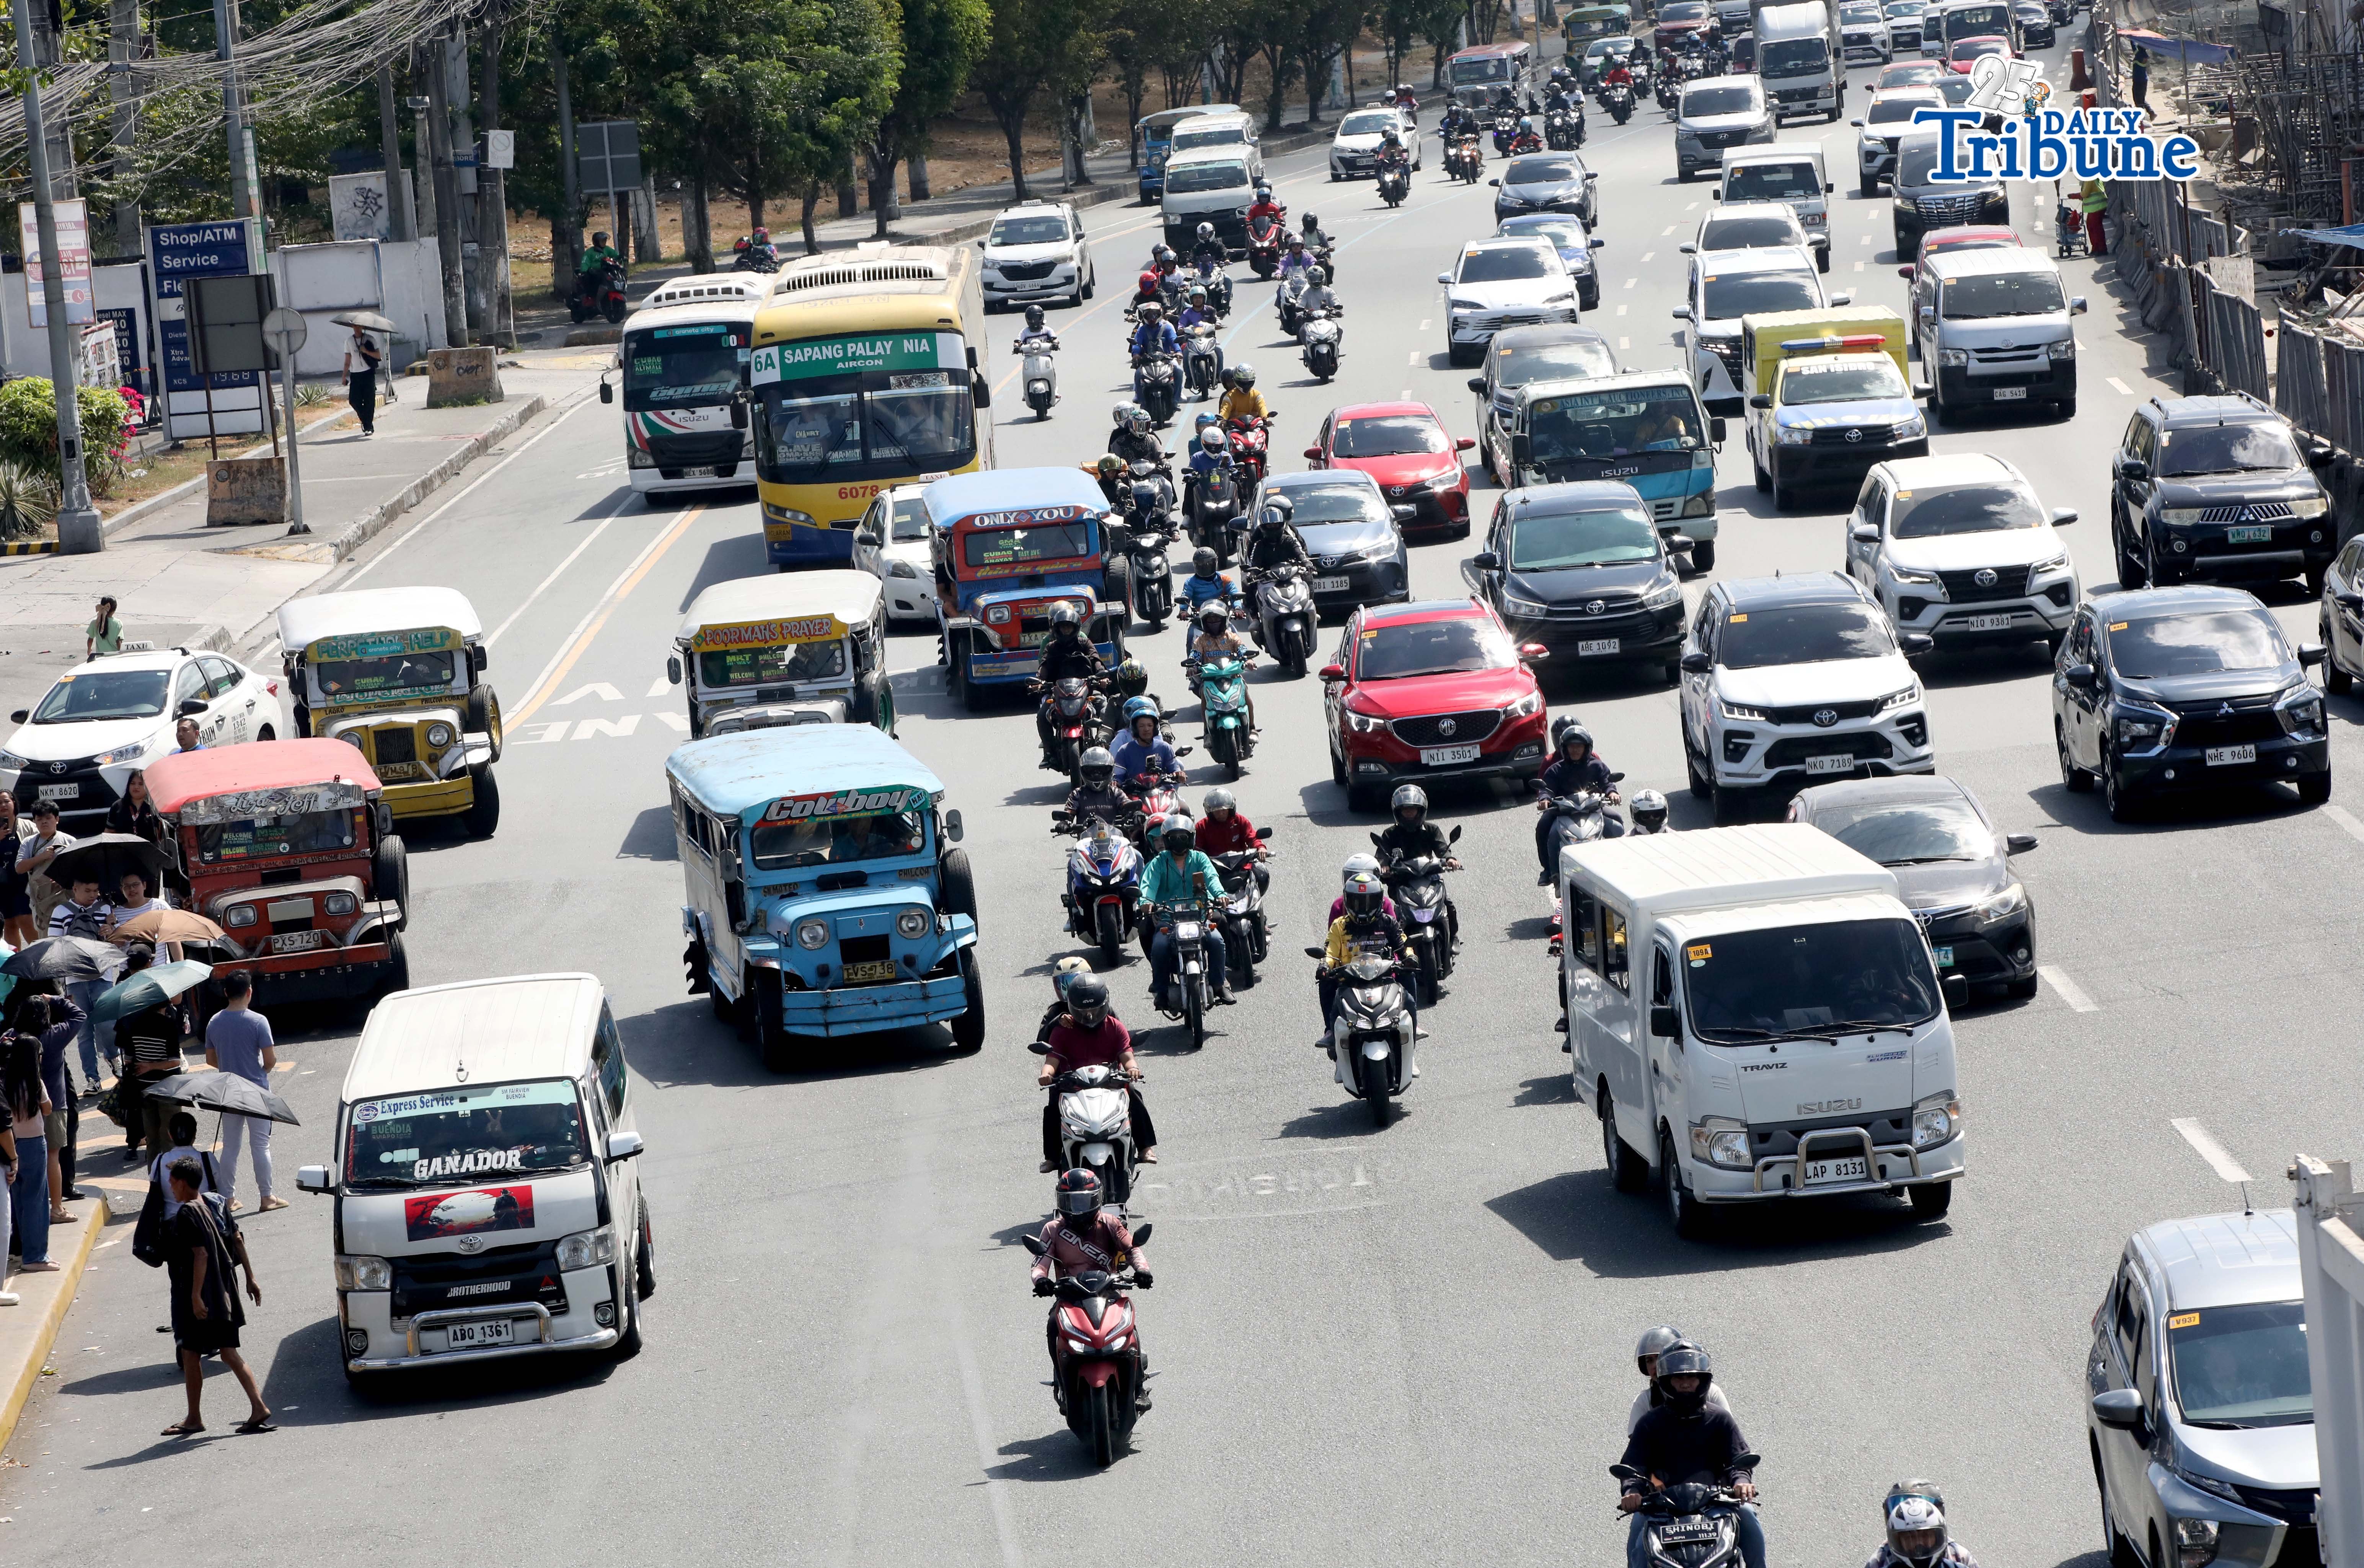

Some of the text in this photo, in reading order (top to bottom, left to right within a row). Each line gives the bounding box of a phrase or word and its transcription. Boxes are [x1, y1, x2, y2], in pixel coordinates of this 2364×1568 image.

[160, 228, 236, 246] Shop/ATM
[163, 254, 218, 268] Service
[722, 334, 745, 347] 004
[754, 339, 930, 372] 6A SAPANG PALAY NIA
[836, 359, 883, 369] AIRCON
[1801, 361, 1875, 376] SAN ISIDRO
[1560, 398, 1577, 408] ASIA
[1601, 466, 1639, 477] ISUZU
[975, 507, 1074, 527] ONLY YOU
[1331, 580, 1348, 588] 1185
[1970, 617, 2010, 629] NIQ 9381
[705, 618, 832, 645] POORMAN'S PRAYER
[1022, 631, 1040, 642] TXA
[409, 630, 452, 651] HELP
[1581, 641, 1617, 652] ABE 1092
[726, 653, 784, 663] MRT PHILCOA
[762, 668, 788, 677] PANTRANCO
[421, 696, 443, 705] PHILCOA
[233, 718, 246, 731] 1342
[1451, 749, 1472, 760] 3501
[2208, 747, 2254, 763] NHE 9606
[1807, 755, 1852, 771] NKQ 7189
[40, 786, 77, 798] NKM 8620
[230, 792, 268, 815] Liza
[277, 792, 319, 816] Jeff
[766, 789, 913, 821] Cowboy
[777, 810, 882, 826] STILL AVAILABLE
[222, 832, 253, 840] WELCOME
[221, 846, 247, 855] WELCOME
[195, 867, 218, 876] ALMAR
[311, 854, 339, 864] WELCOME
[341, 850, 366, 860] ROTONDA
[898, 867, 931, 879] PHILCOA
[273, 932, 320, 948] PXS 720
[1692, 948, 1709, 957] 109A
[845, 966, 867, 979] TVS
[873, 962, 895, 976] 738
[1741, 1063, 1788, 1072] TRAVIZ
[380, 1099, 418, 1116] Express
[420, 1093, 454, 1109] Service
[1797, 1097, 1862, 1115] ISUZU
[371, 1122, 412, 1135] BUENDIA
[414, 1149, 521, 1178] GANADOR
[1806, 1161, 1865, 1180] LAP 8131
[447, 1280, 511, 1298] BROTHERHOOD
[2176, 1316, 2196, 1325] V937
[453, 1323, 509, 1342] ABQ 1361
[1666, 1523, 1715, 1535] SHINOBI
